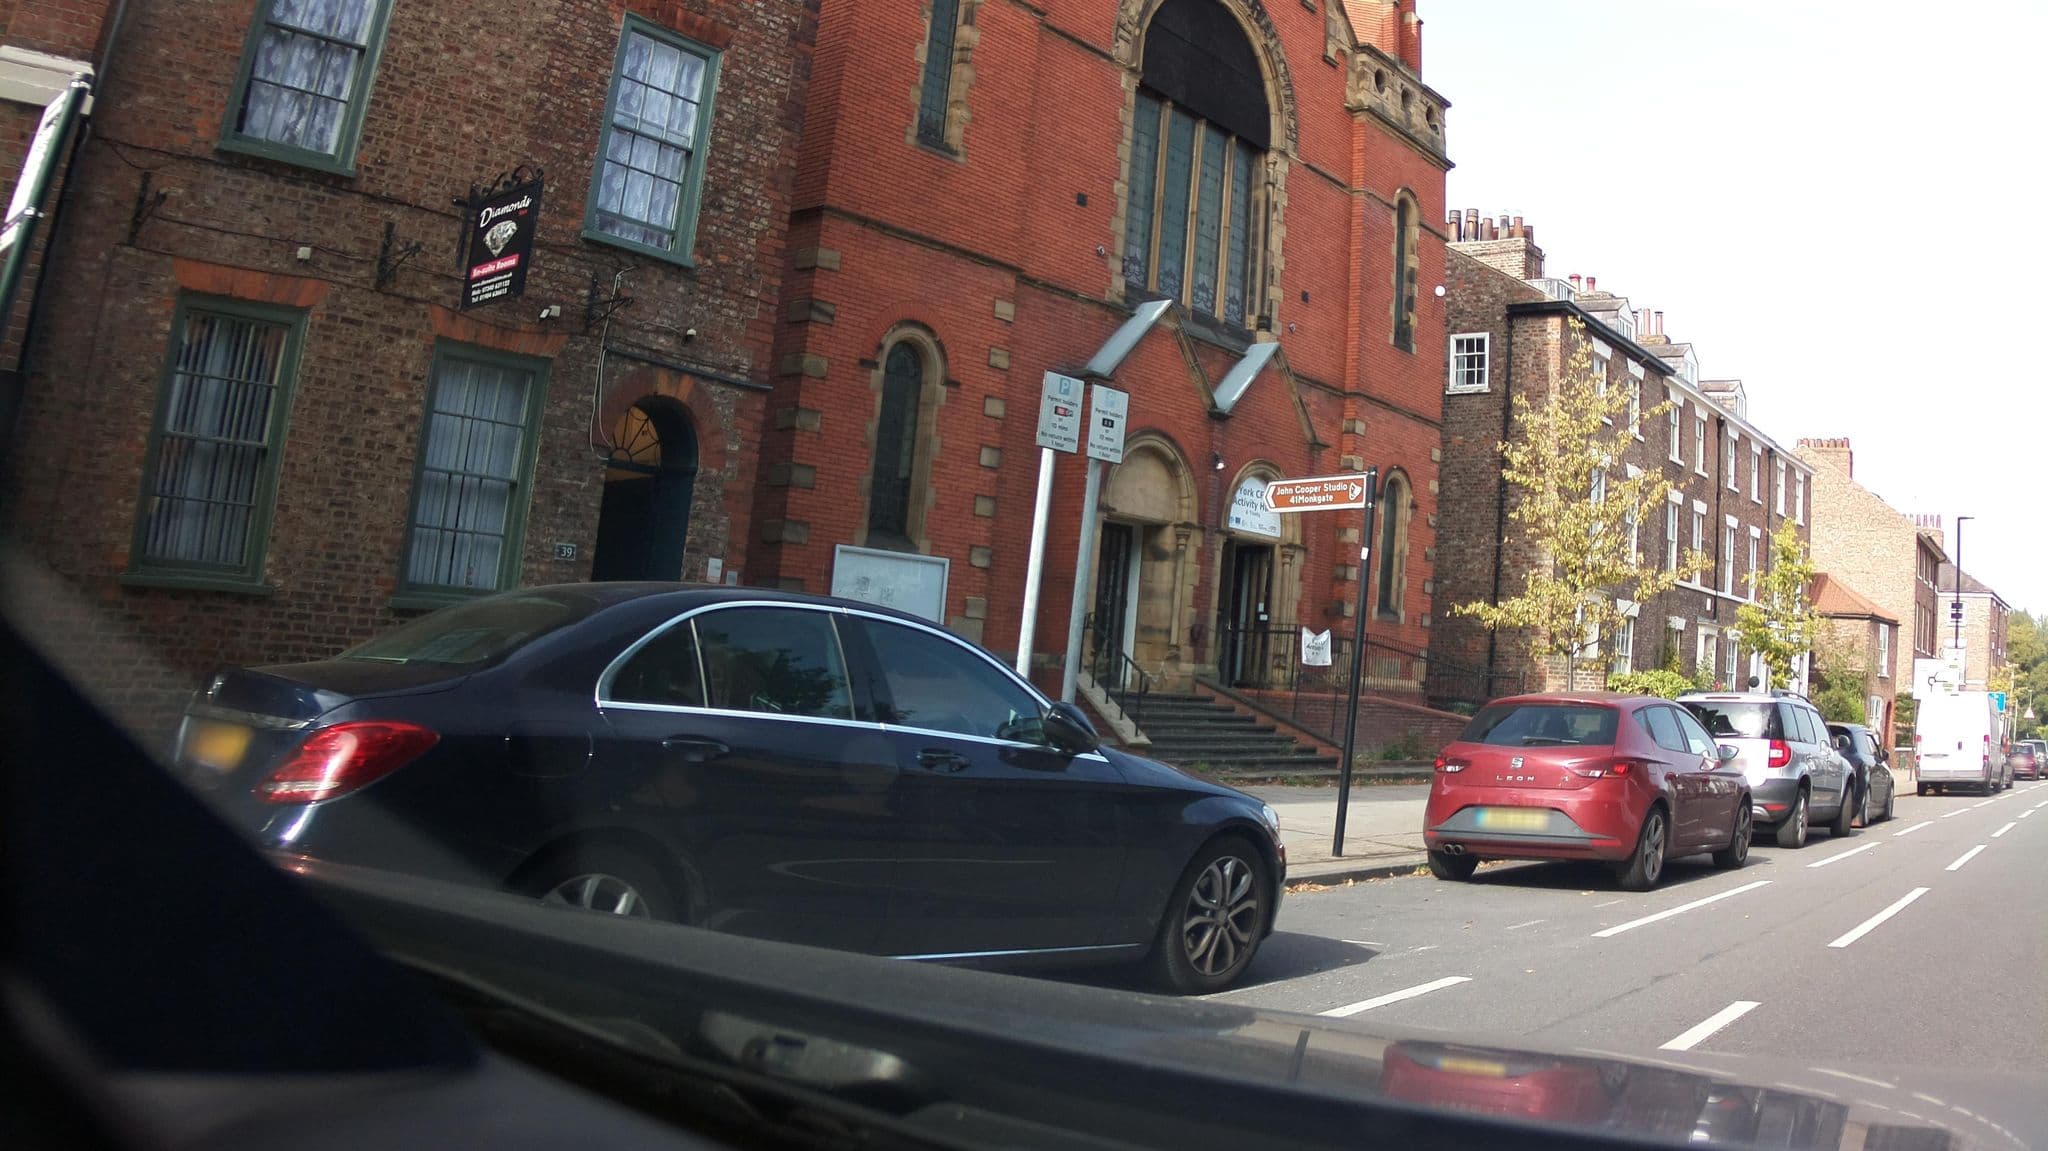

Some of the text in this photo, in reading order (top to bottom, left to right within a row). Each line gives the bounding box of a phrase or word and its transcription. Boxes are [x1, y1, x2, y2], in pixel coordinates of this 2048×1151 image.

[480, 195, 532, 228] Diamonds
[1239, 487, 1254, 498] York
[1277, 482, 1347, 496] John Cooper Studio
[1233, 496, 1258, 511] Activity
[1290, 492, 1334, 504] 41Monkgate
[561, 546, 573, 557] 39
